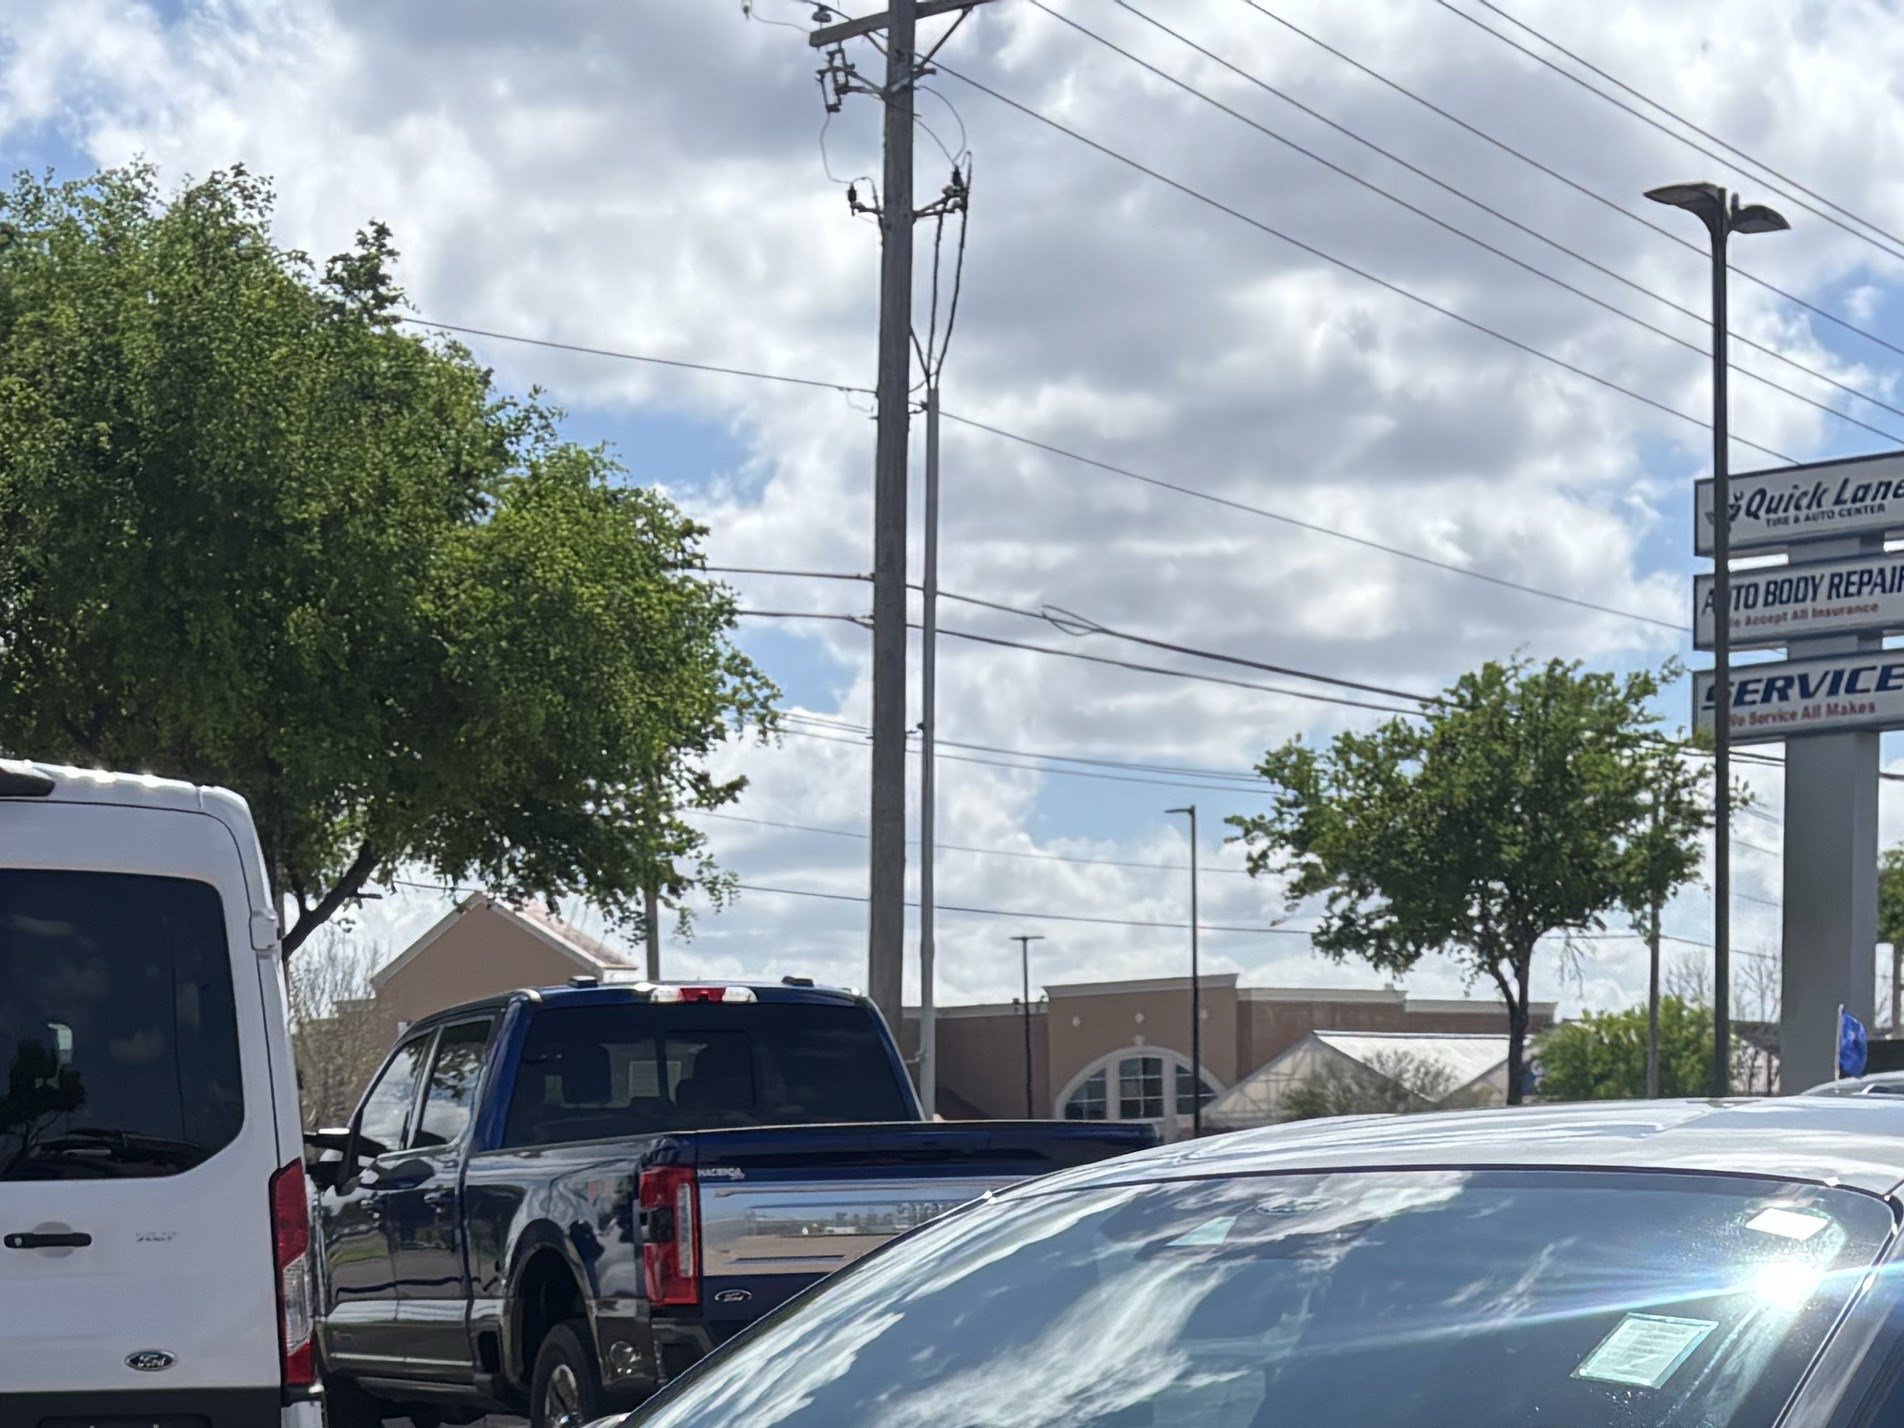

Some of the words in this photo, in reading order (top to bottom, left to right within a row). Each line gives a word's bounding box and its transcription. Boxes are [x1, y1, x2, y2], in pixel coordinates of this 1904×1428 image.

[1745, 480, 1829, 520] Quick
[1765, 515, 1789, 528] TIRE
[1804, 509, 1836, 522] AUTO
[1838, 503, 1886, 518] CENTER
[1701, 582, 1759, 616] ATO
[1763, 573, 1825, 609] BODY
[1745, 607, 1789, 627] Accept
[1791, 604, 1809, 620] All
[1812, 602, 1879, 617] Insurance
[1749, 708, 1797, 727] Service
[1801, 705, 1822, 721] All
[1826, 701, 1876, 718] Makes
